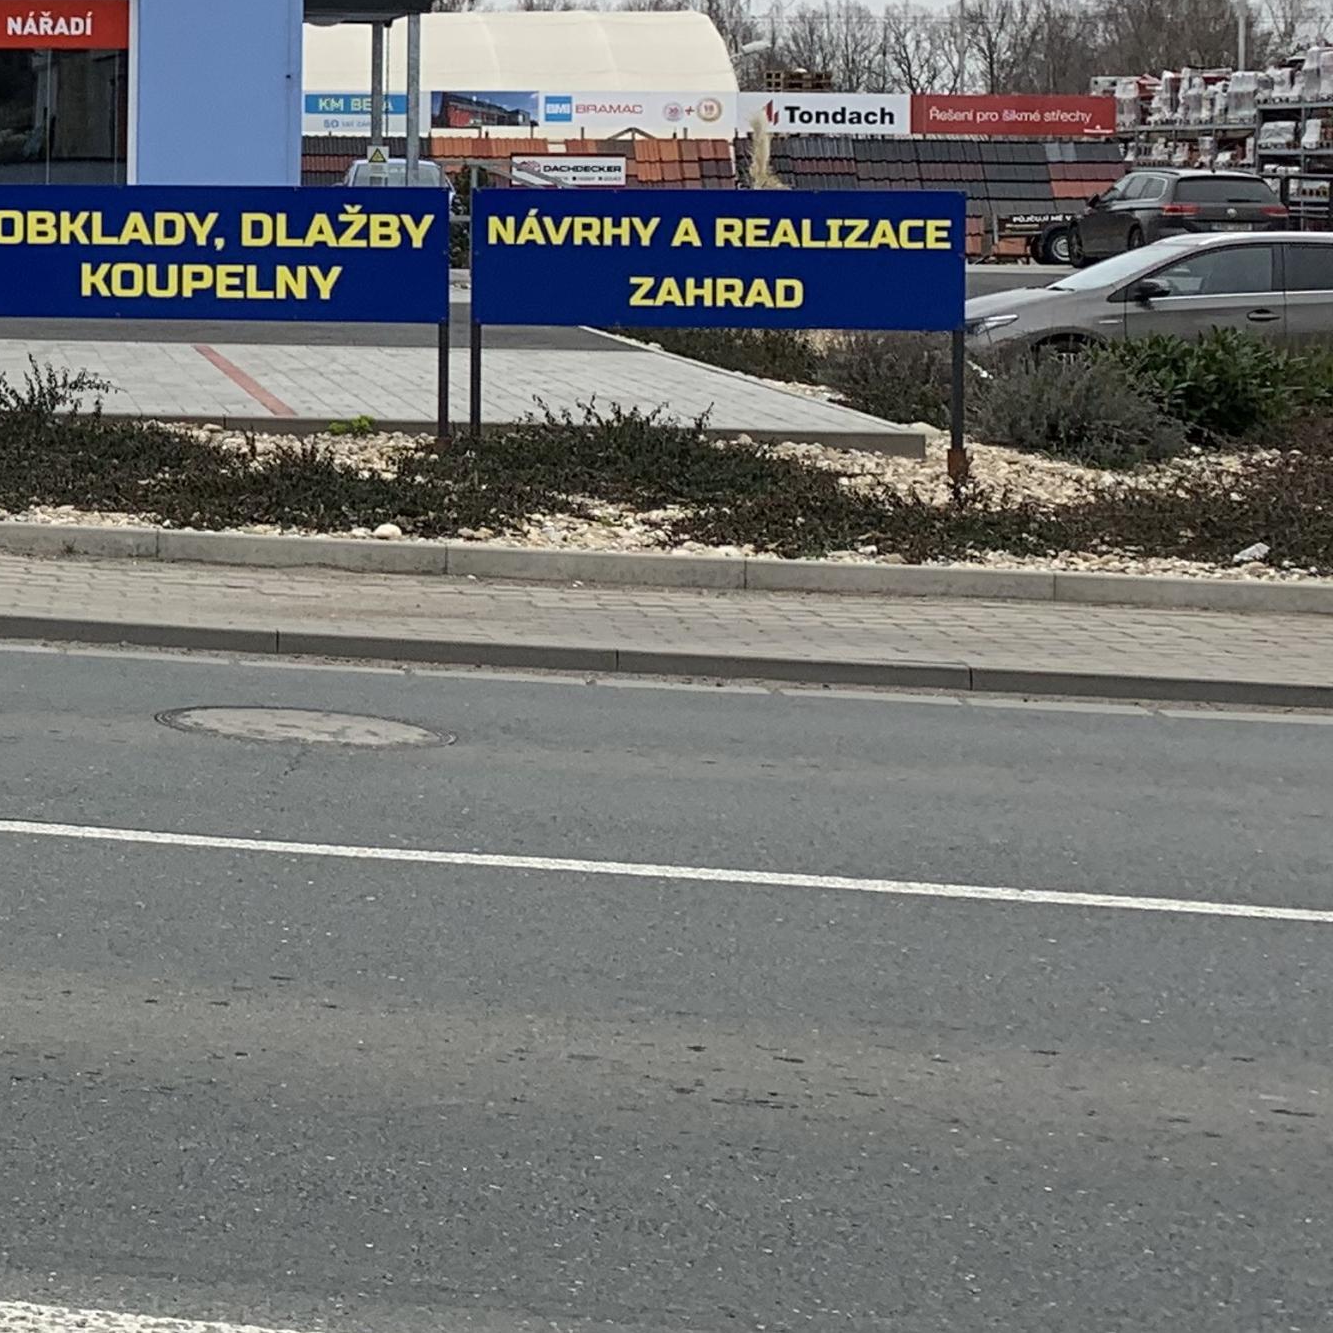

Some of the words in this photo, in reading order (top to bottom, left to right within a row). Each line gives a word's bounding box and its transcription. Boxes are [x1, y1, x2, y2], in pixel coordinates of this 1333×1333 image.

[6, 11, 93, 36] NÁŘADÍ
[318, 98, 344, 111] KM
[351, 98, 394, 111] BEA
[575, 104, 644, 115] BRAMAC
[784, 105, 895, 125] Tondach
[929, 106, 974, 121] Řešení
[976, 112, 999, 123] pro
[1002, 109, 1040, 122] šikmé
[1043, 109, 1092, 124] střechy
[241, 205, 434, 248] DLAŽBY
[488, 211, 660, 246] NÁVRHY
[672, 217, 701, 247] A
[715, 217, 952, 250] REALIZACE
[81, 262, 342, 301] KOUPELNY
[629, 276, 805, 309] ZAHRAD
